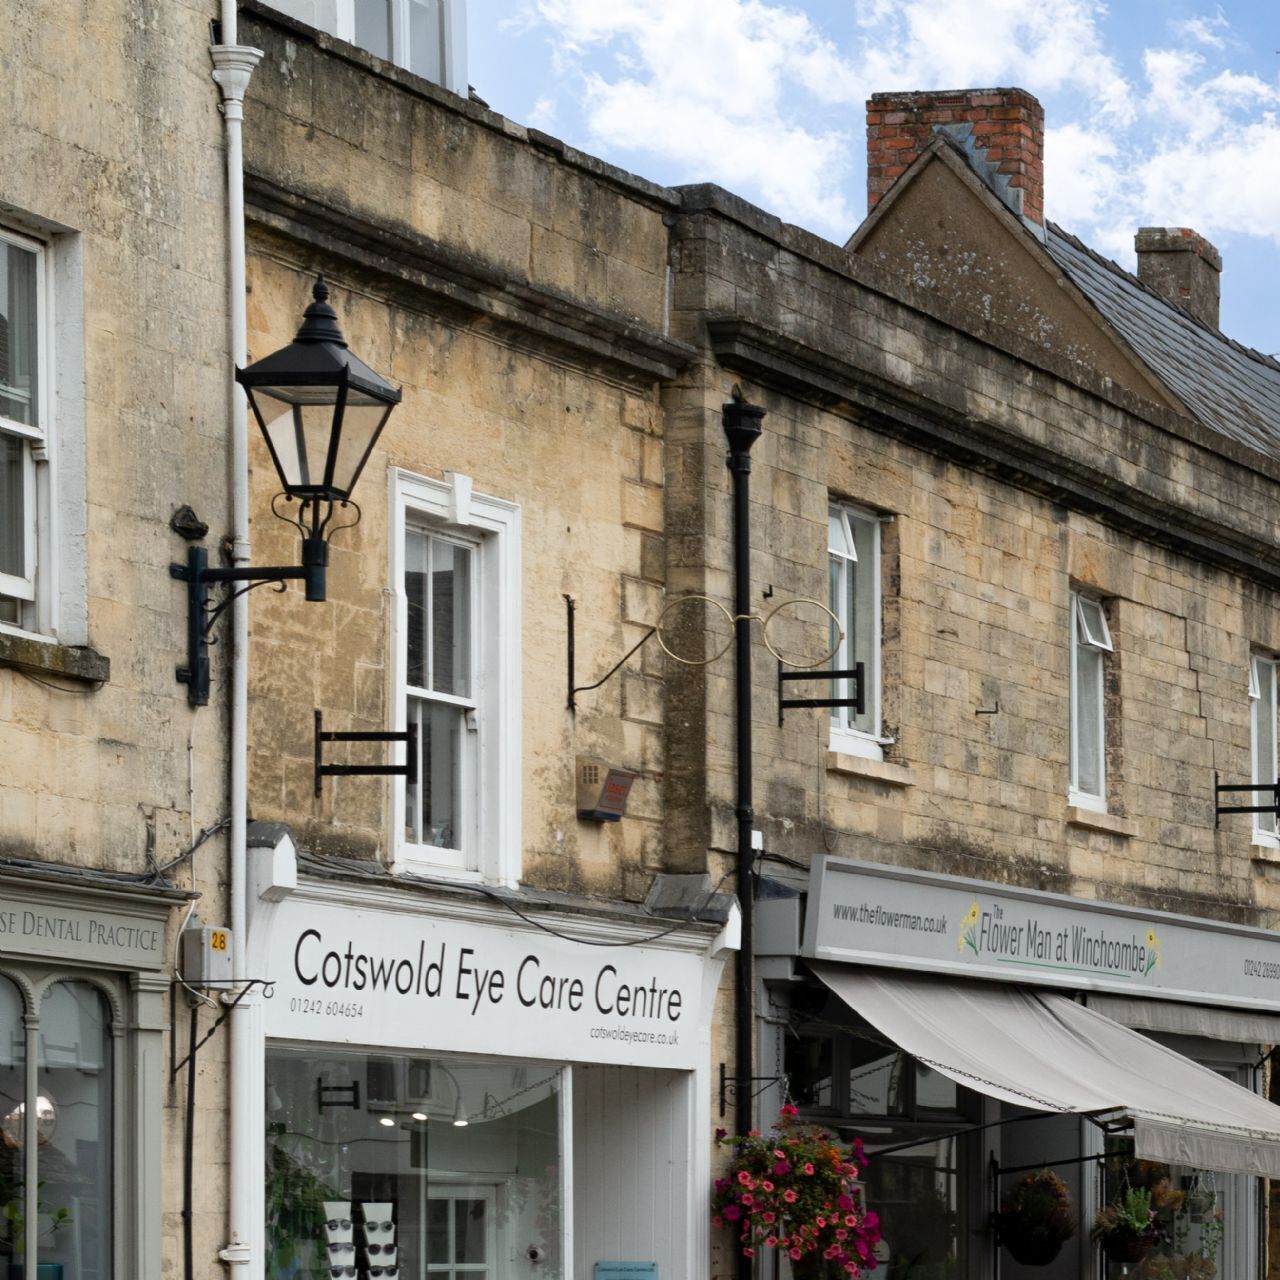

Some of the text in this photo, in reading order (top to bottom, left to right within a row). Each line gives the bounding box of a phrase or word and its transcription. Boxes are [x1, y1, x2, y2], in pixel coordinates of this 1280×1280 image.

[833, 903, 948, 934] www.theflowerman.co.uk
[994, 904, 1003, 920] The
[22, 911, 82, 942] DENTAL
[88, 919, 158, 951] PRACTICE
[211, 932, 227, 950] 28
[979, 912, 1146, 973] Flower Man at Winchcombe
[294, 929, 682, 1021] Cotswold Eye Care Centre
[290, 997, 364, 1018] 01242 604654
[589, 1023, 679, 1046] cotswoldeyecare.co.uk
